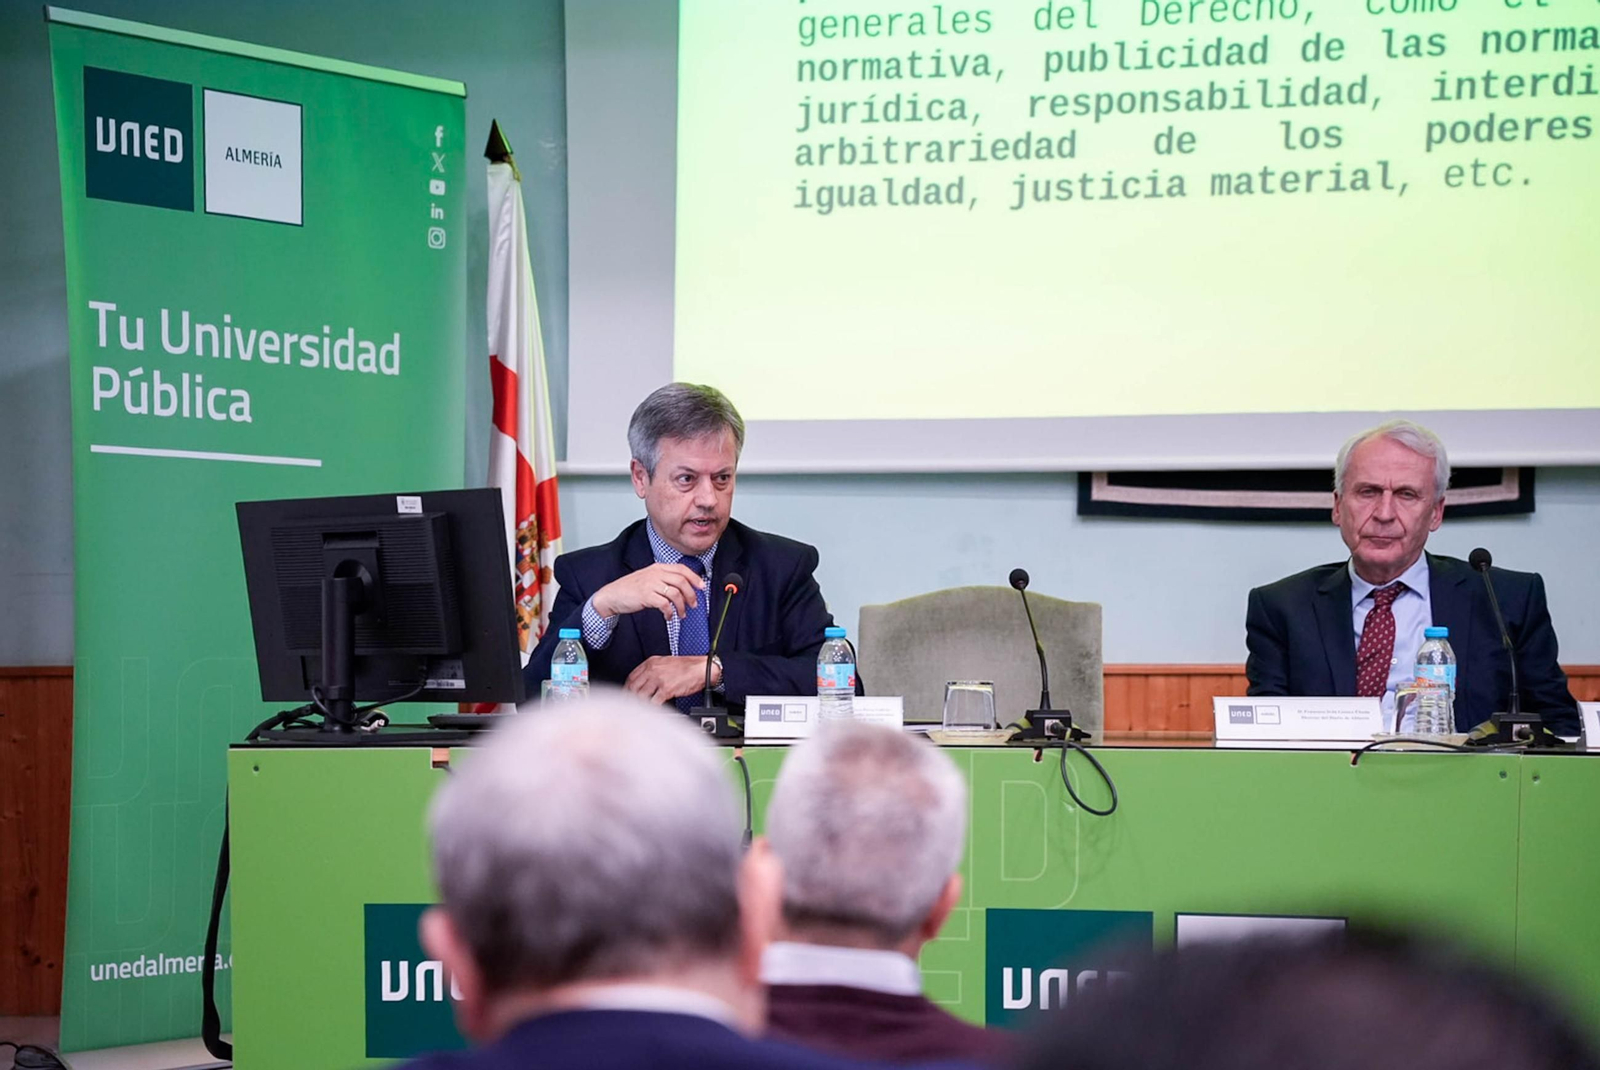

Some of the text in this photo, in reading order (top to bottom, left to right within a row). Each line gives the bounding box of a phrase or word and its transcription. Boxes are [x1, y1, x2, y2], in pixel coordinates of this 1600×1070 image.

[799, 5, 993, 47] generales
[1033, 0, 1098, 31] del
[1140, 0, 1314, 27] Derecho,
[796, 25, 1600, 83] normativa, publicidad de las norma
[796, 64, 1600, 133] jurídica, responsabilidad, interdi
[95, 115, 184, 164] UNED
[224, 145, 283, 169] ALMERÍA
[795, 112, 1593, 167] arbitrariedad de los poderes
[793, 157, 1532, 216] igualdad, justicia material, etc.
[88, 300, 400, 376] Tu Universidad
[92, 366, 252, 423] Pública
[90, 953, 232, 981] unedalmera.
[381, 960, 466, 1001] UN
